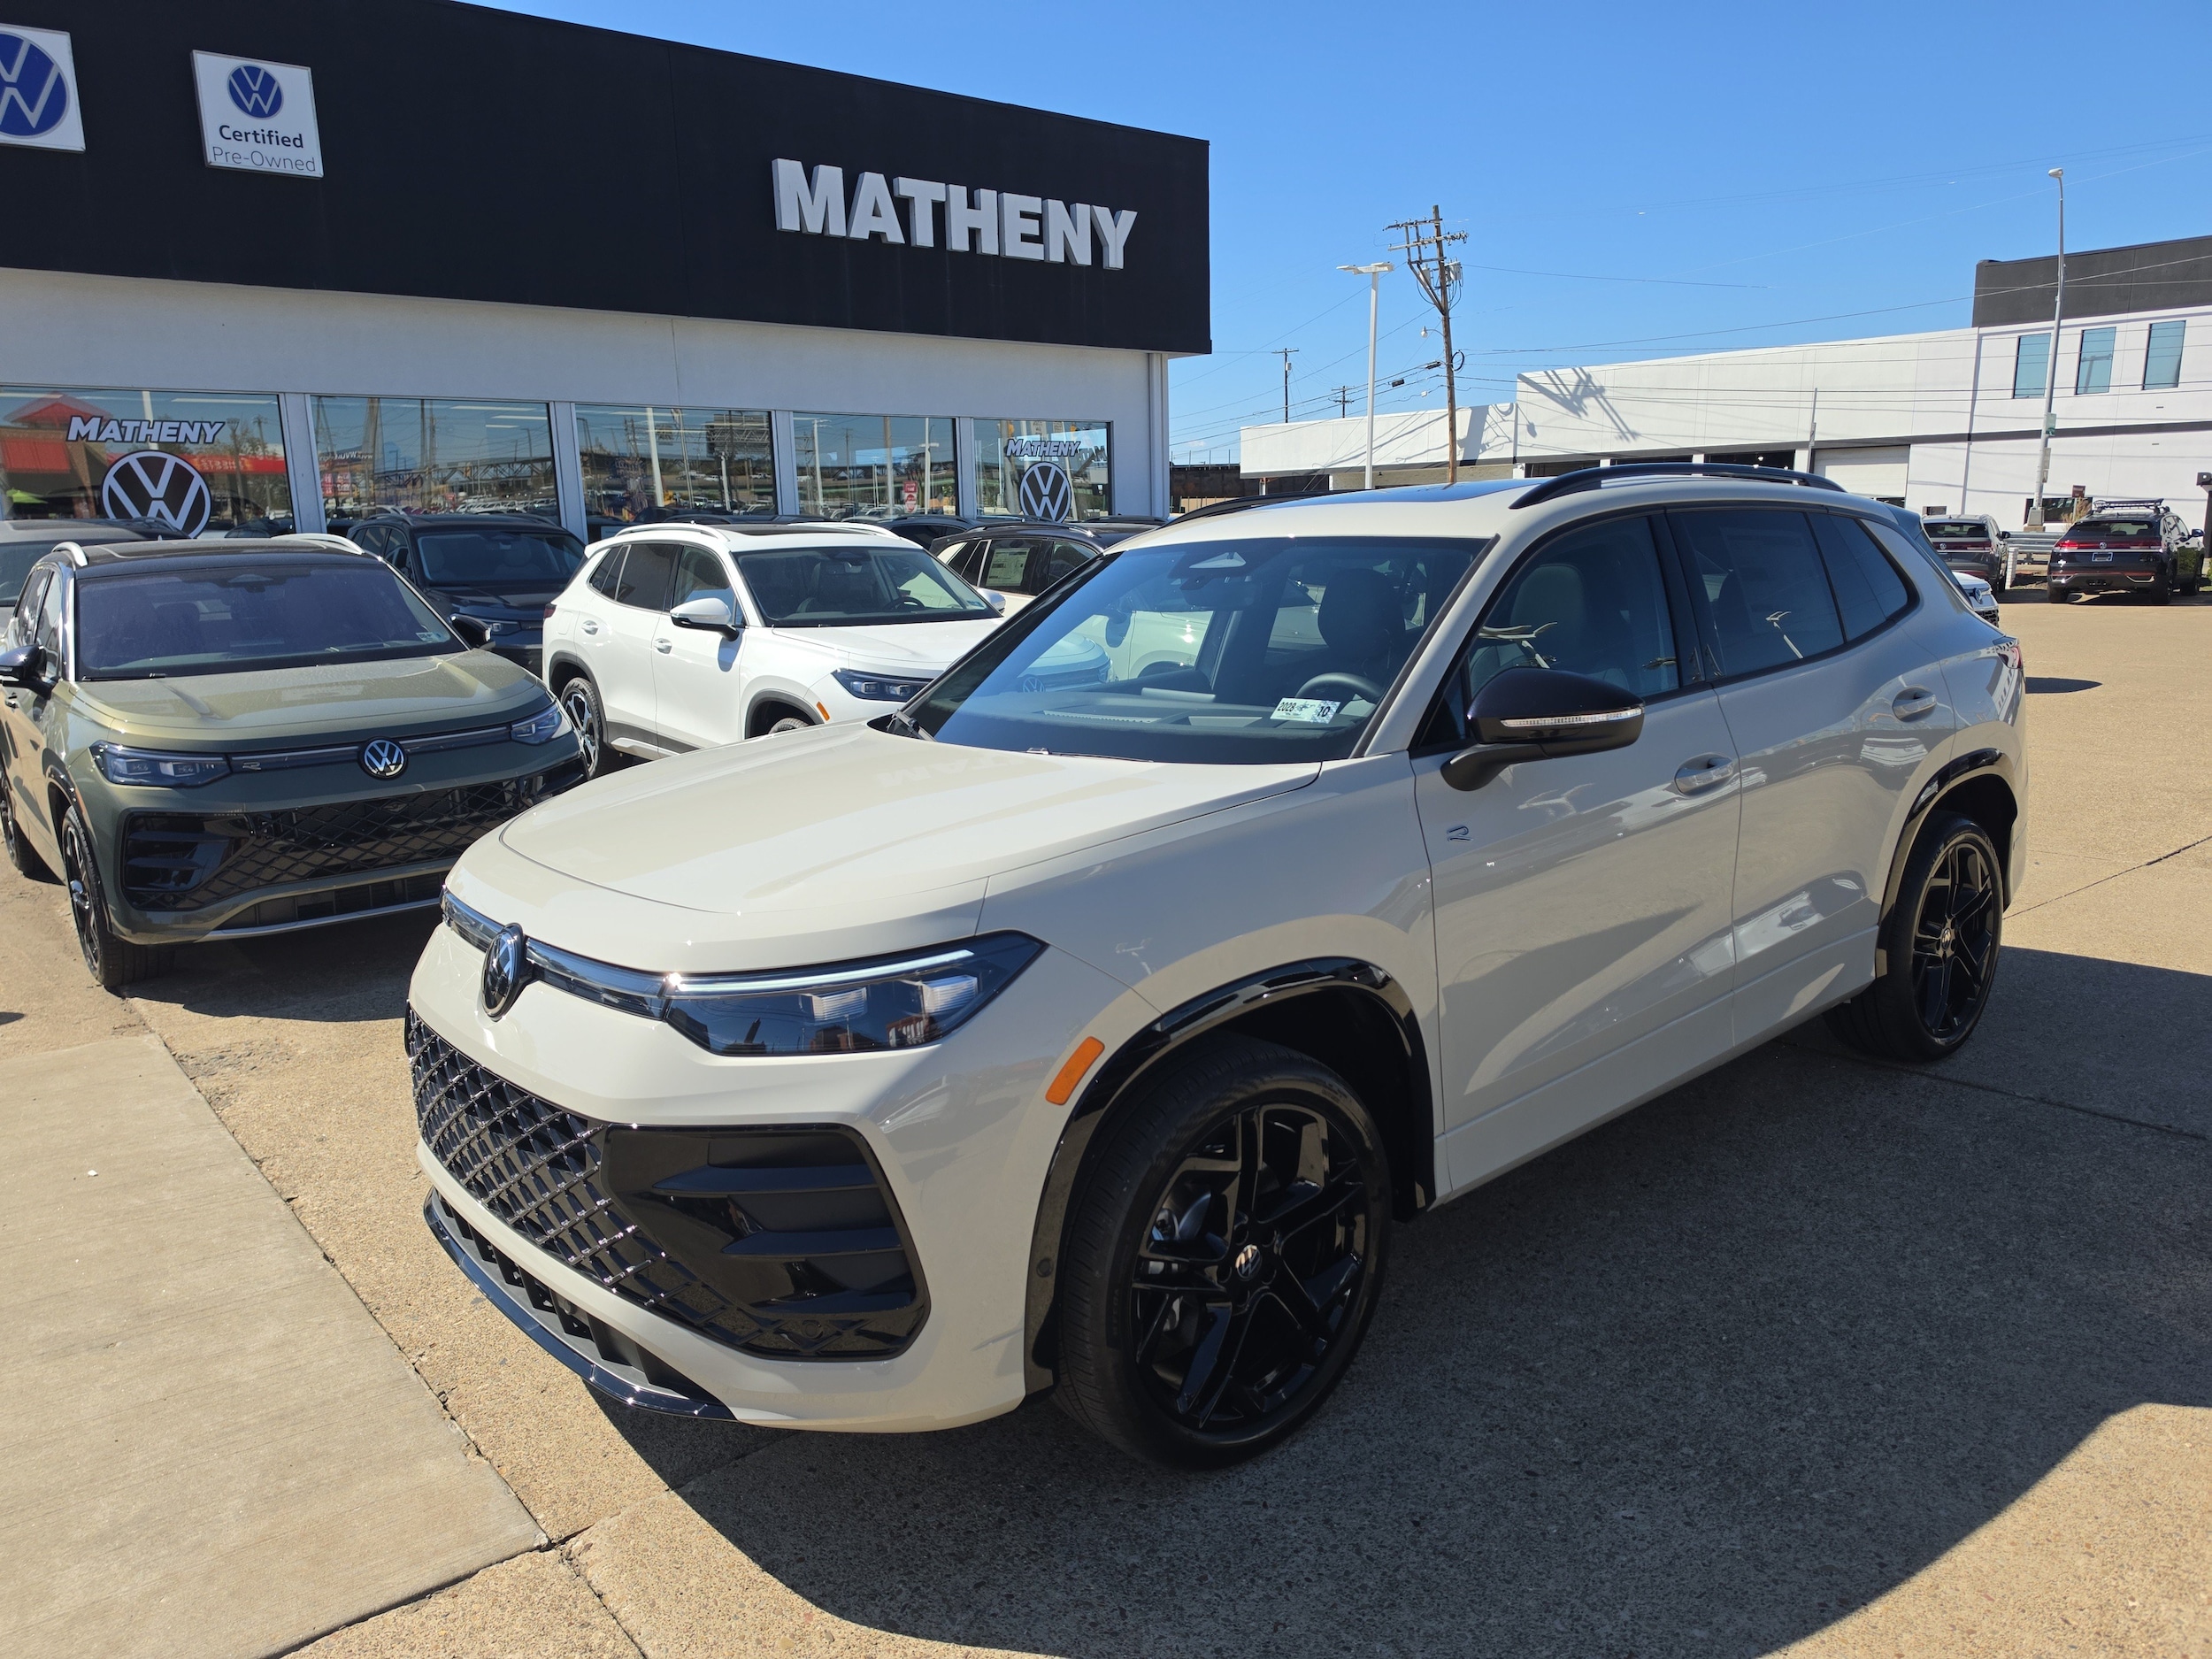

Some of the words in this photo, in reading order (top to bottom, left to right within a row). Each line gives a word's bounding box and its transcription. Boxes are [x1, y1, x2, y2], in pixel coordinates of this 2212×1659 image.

[227, 64, 284, 120] VW
[219, 124, 304, 149] Certified
[211, 146, 317, 173] Pre-Owned
[772, 157, 1139, 271] MATHENY
[66, 415, 225, 443] MATHENY
[1005, 438, 1081, 457] MATHENY
[102, 449, 211, 539] VW
[1019, 462, 1071, 524] VW
[1317, 705, 1332, 718] 10
[364, 739, 404, 777] VW
